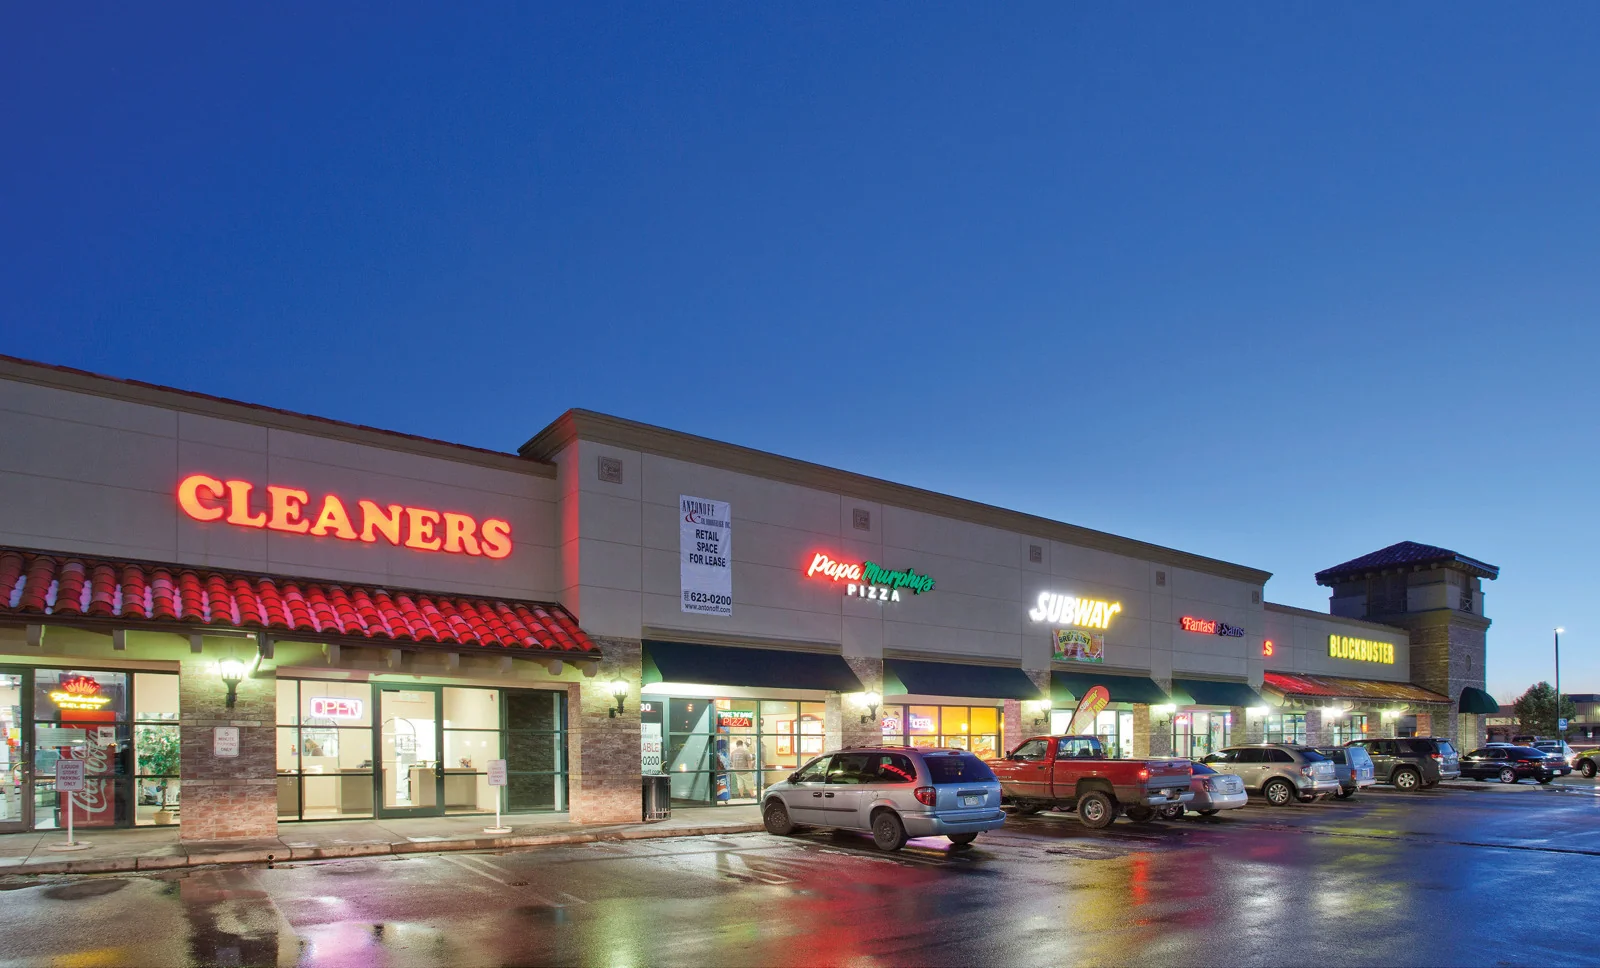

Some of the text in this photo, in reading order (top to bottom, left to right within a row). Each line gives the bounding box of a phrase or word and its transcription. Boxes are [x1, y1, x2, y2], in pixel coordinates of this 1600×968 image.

[682, 500, 715, 516] ANTONOFF
[177, 474, 513, 559] CLEANERS
[695, 529, 719, 541] RETAIL
[697, 542, 718, 554] SPACE
[689, 553, 726, 567] FOR LEASE
[808, 553, 935, 594] Papa Murphy's
[690, 592, 731, 605] 623-0200
[847, 584, 900, 601] PIZZA
[685, 604, 731, 613] www.antonoff.com
[1029, 592, 1121, 628] SUBWAY
[1181, 616, 1244, 637] Fantastic Sams
[1329, 634, 1393, 664] BLOCKBUSTER
[313, 700, 360, 716] OPEN
[723, 717, 750, 726] PIZZA
